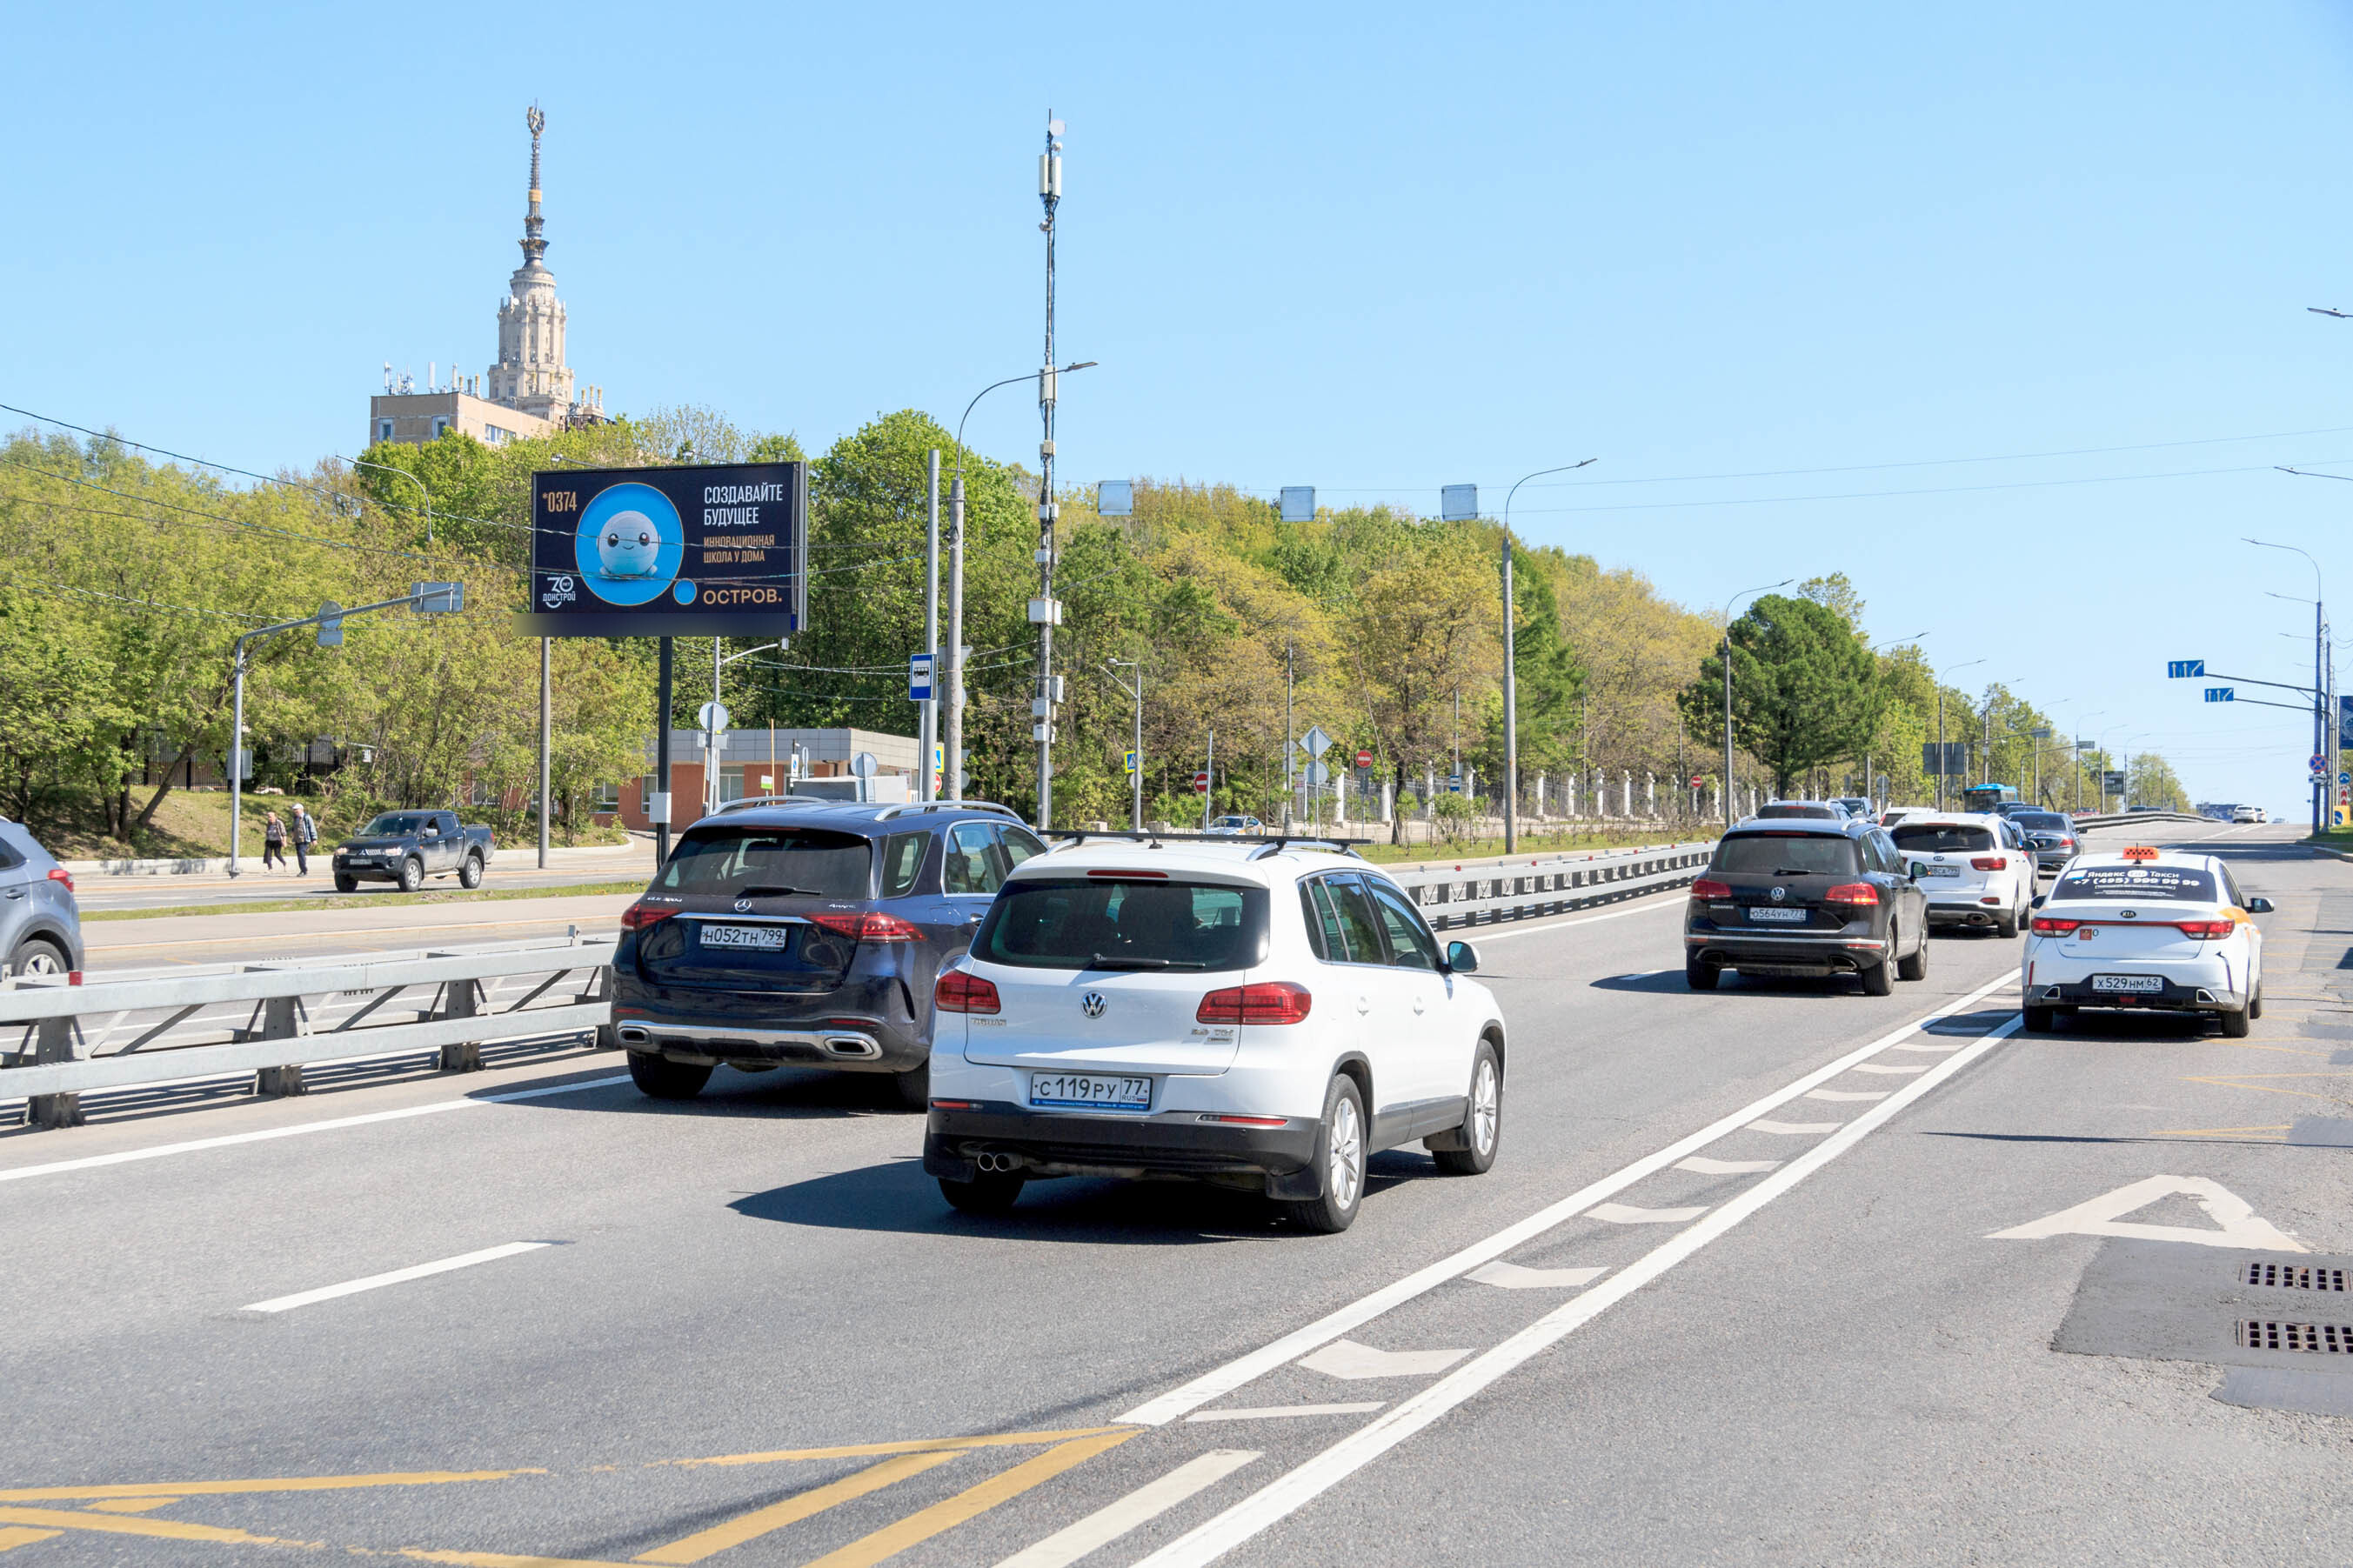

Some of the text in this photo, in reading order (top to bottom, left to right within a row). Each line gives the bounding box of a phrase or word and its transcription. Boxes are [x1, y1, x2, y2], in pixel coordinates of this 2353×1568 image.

[704, 482, 783, 504] СОЗДАВАЙТЕ
[704, 507, 759, 527] БУДУЩЕЕ
[703, 534, 775, 549] ИННОВАЦИОННАЯ
[703, 550, 765, 564] ШКОЛА У ДОМА
[542, 591, 576, 602] ДОНСТРОЙ
[703, 589, 783, 604] ОСТРОВ.
[761, 929, 782, 941] 799
[2146, 977, 2158, 987] 62
[1039, 1078, 1143, 1100] С119РУ 77
[1121, 1094, 1137, 1103] RUS
